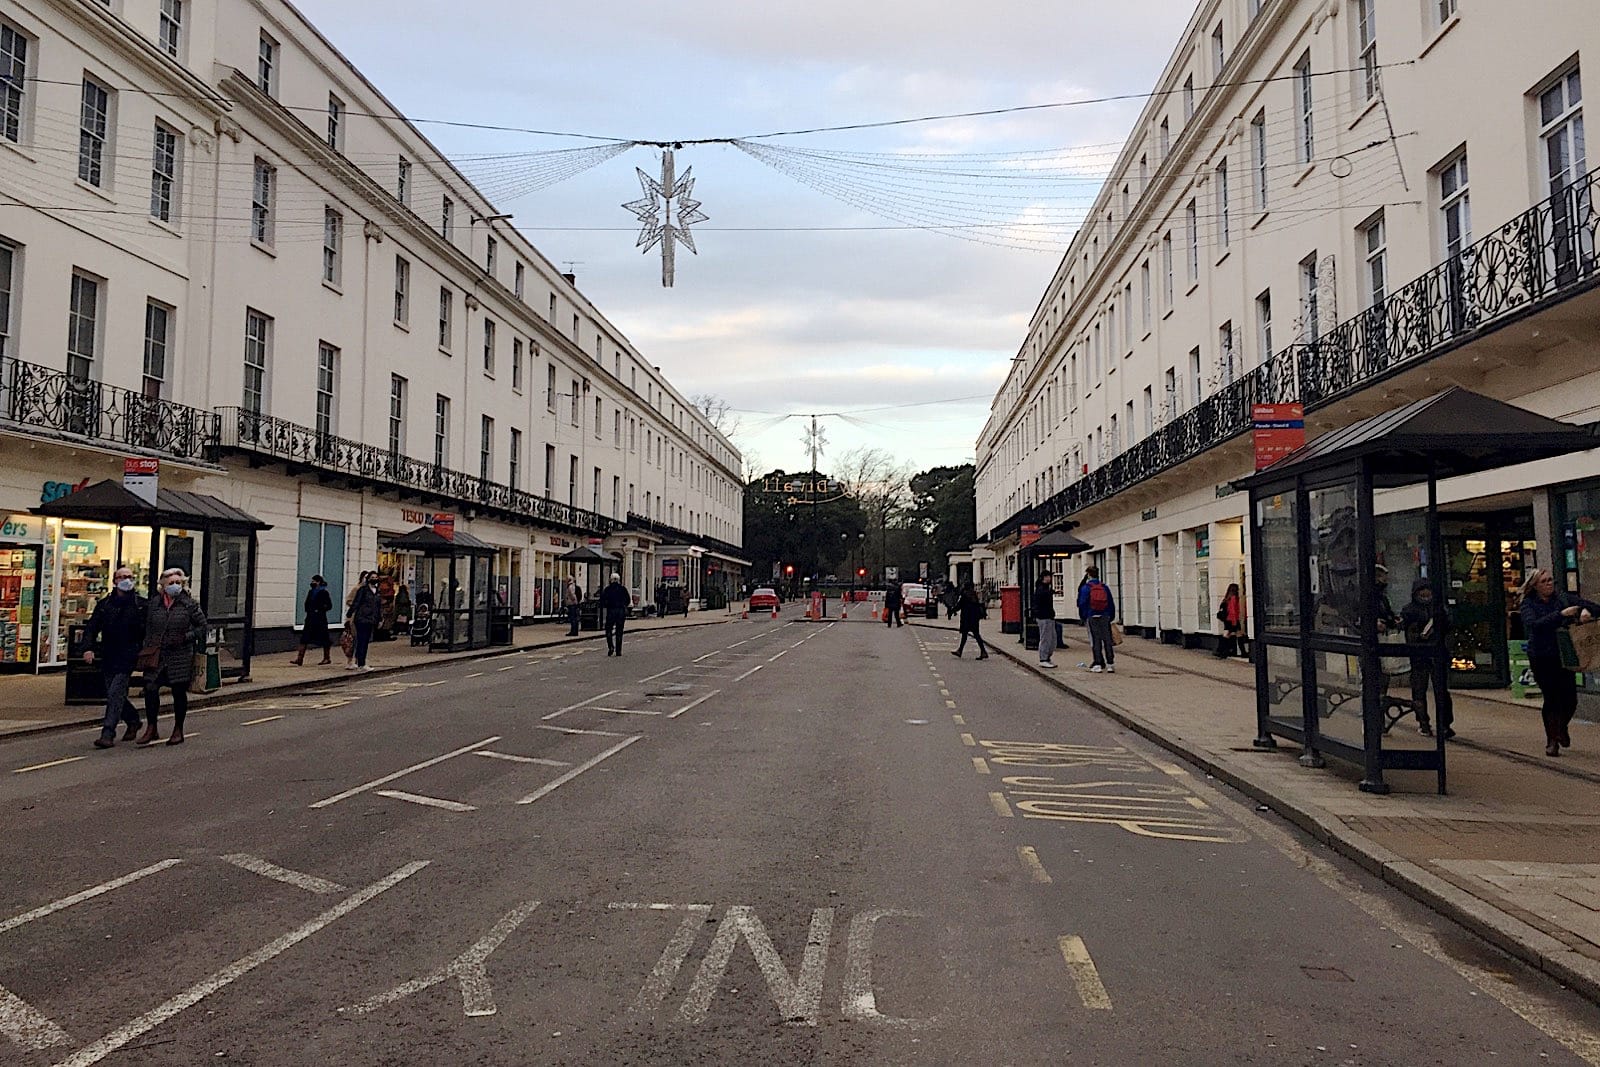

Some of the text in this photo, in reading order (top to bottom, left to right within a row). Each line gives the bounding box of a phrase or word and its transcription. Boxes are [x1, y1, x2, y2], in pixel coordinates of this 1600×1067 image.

[126, 459, 158, 469] bus stop
[402, 509, 424, 524] TESCO
